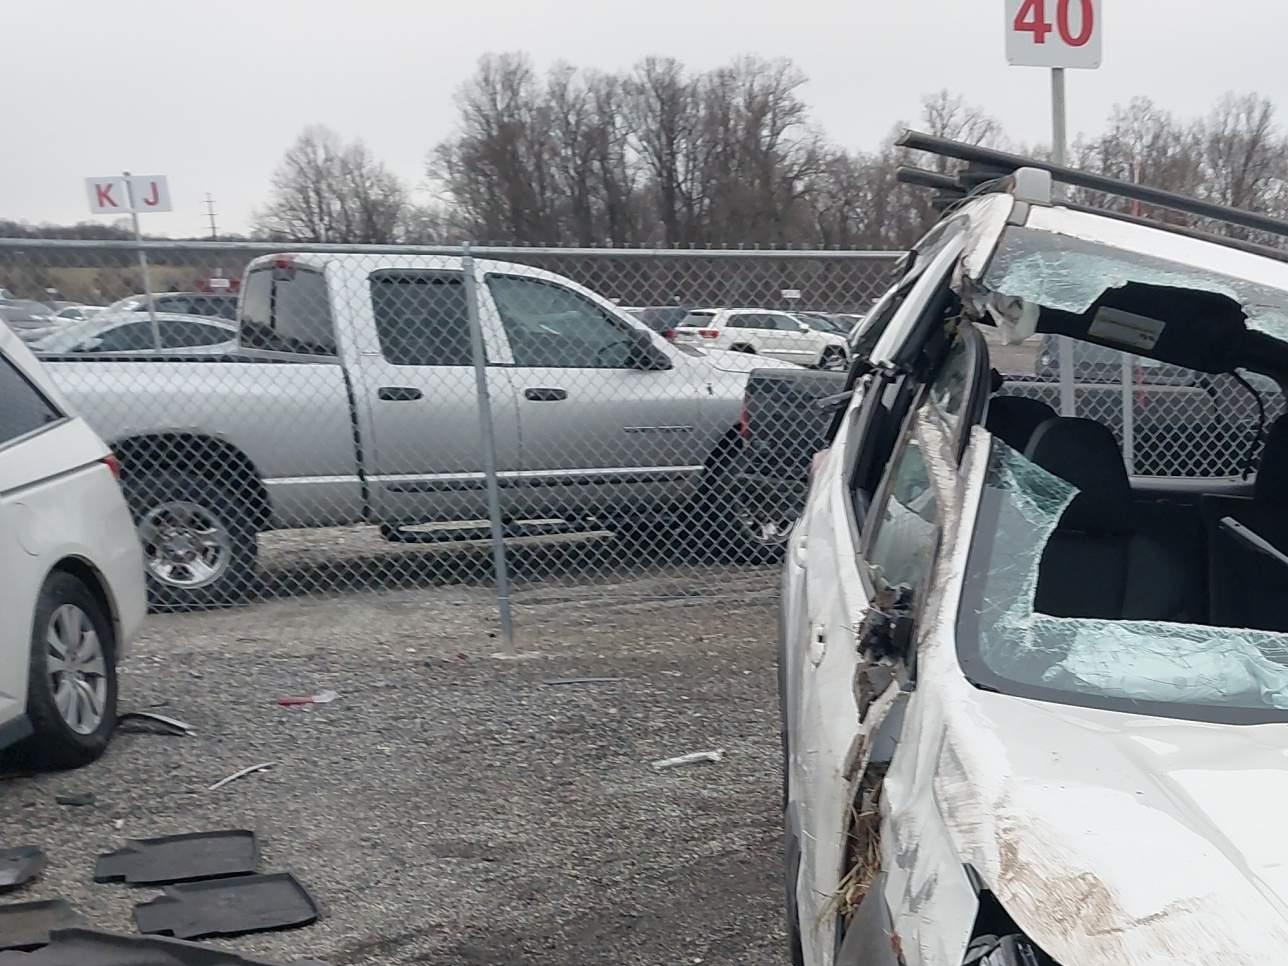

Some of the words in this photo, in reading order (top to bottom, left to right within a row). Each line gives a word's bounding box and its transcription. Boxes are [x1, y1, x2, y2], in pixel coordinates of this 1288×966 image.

[1013, 0, 1094, 47] 40
[95, 183, 118, 208] K
[143, 182, 160, 206] J
